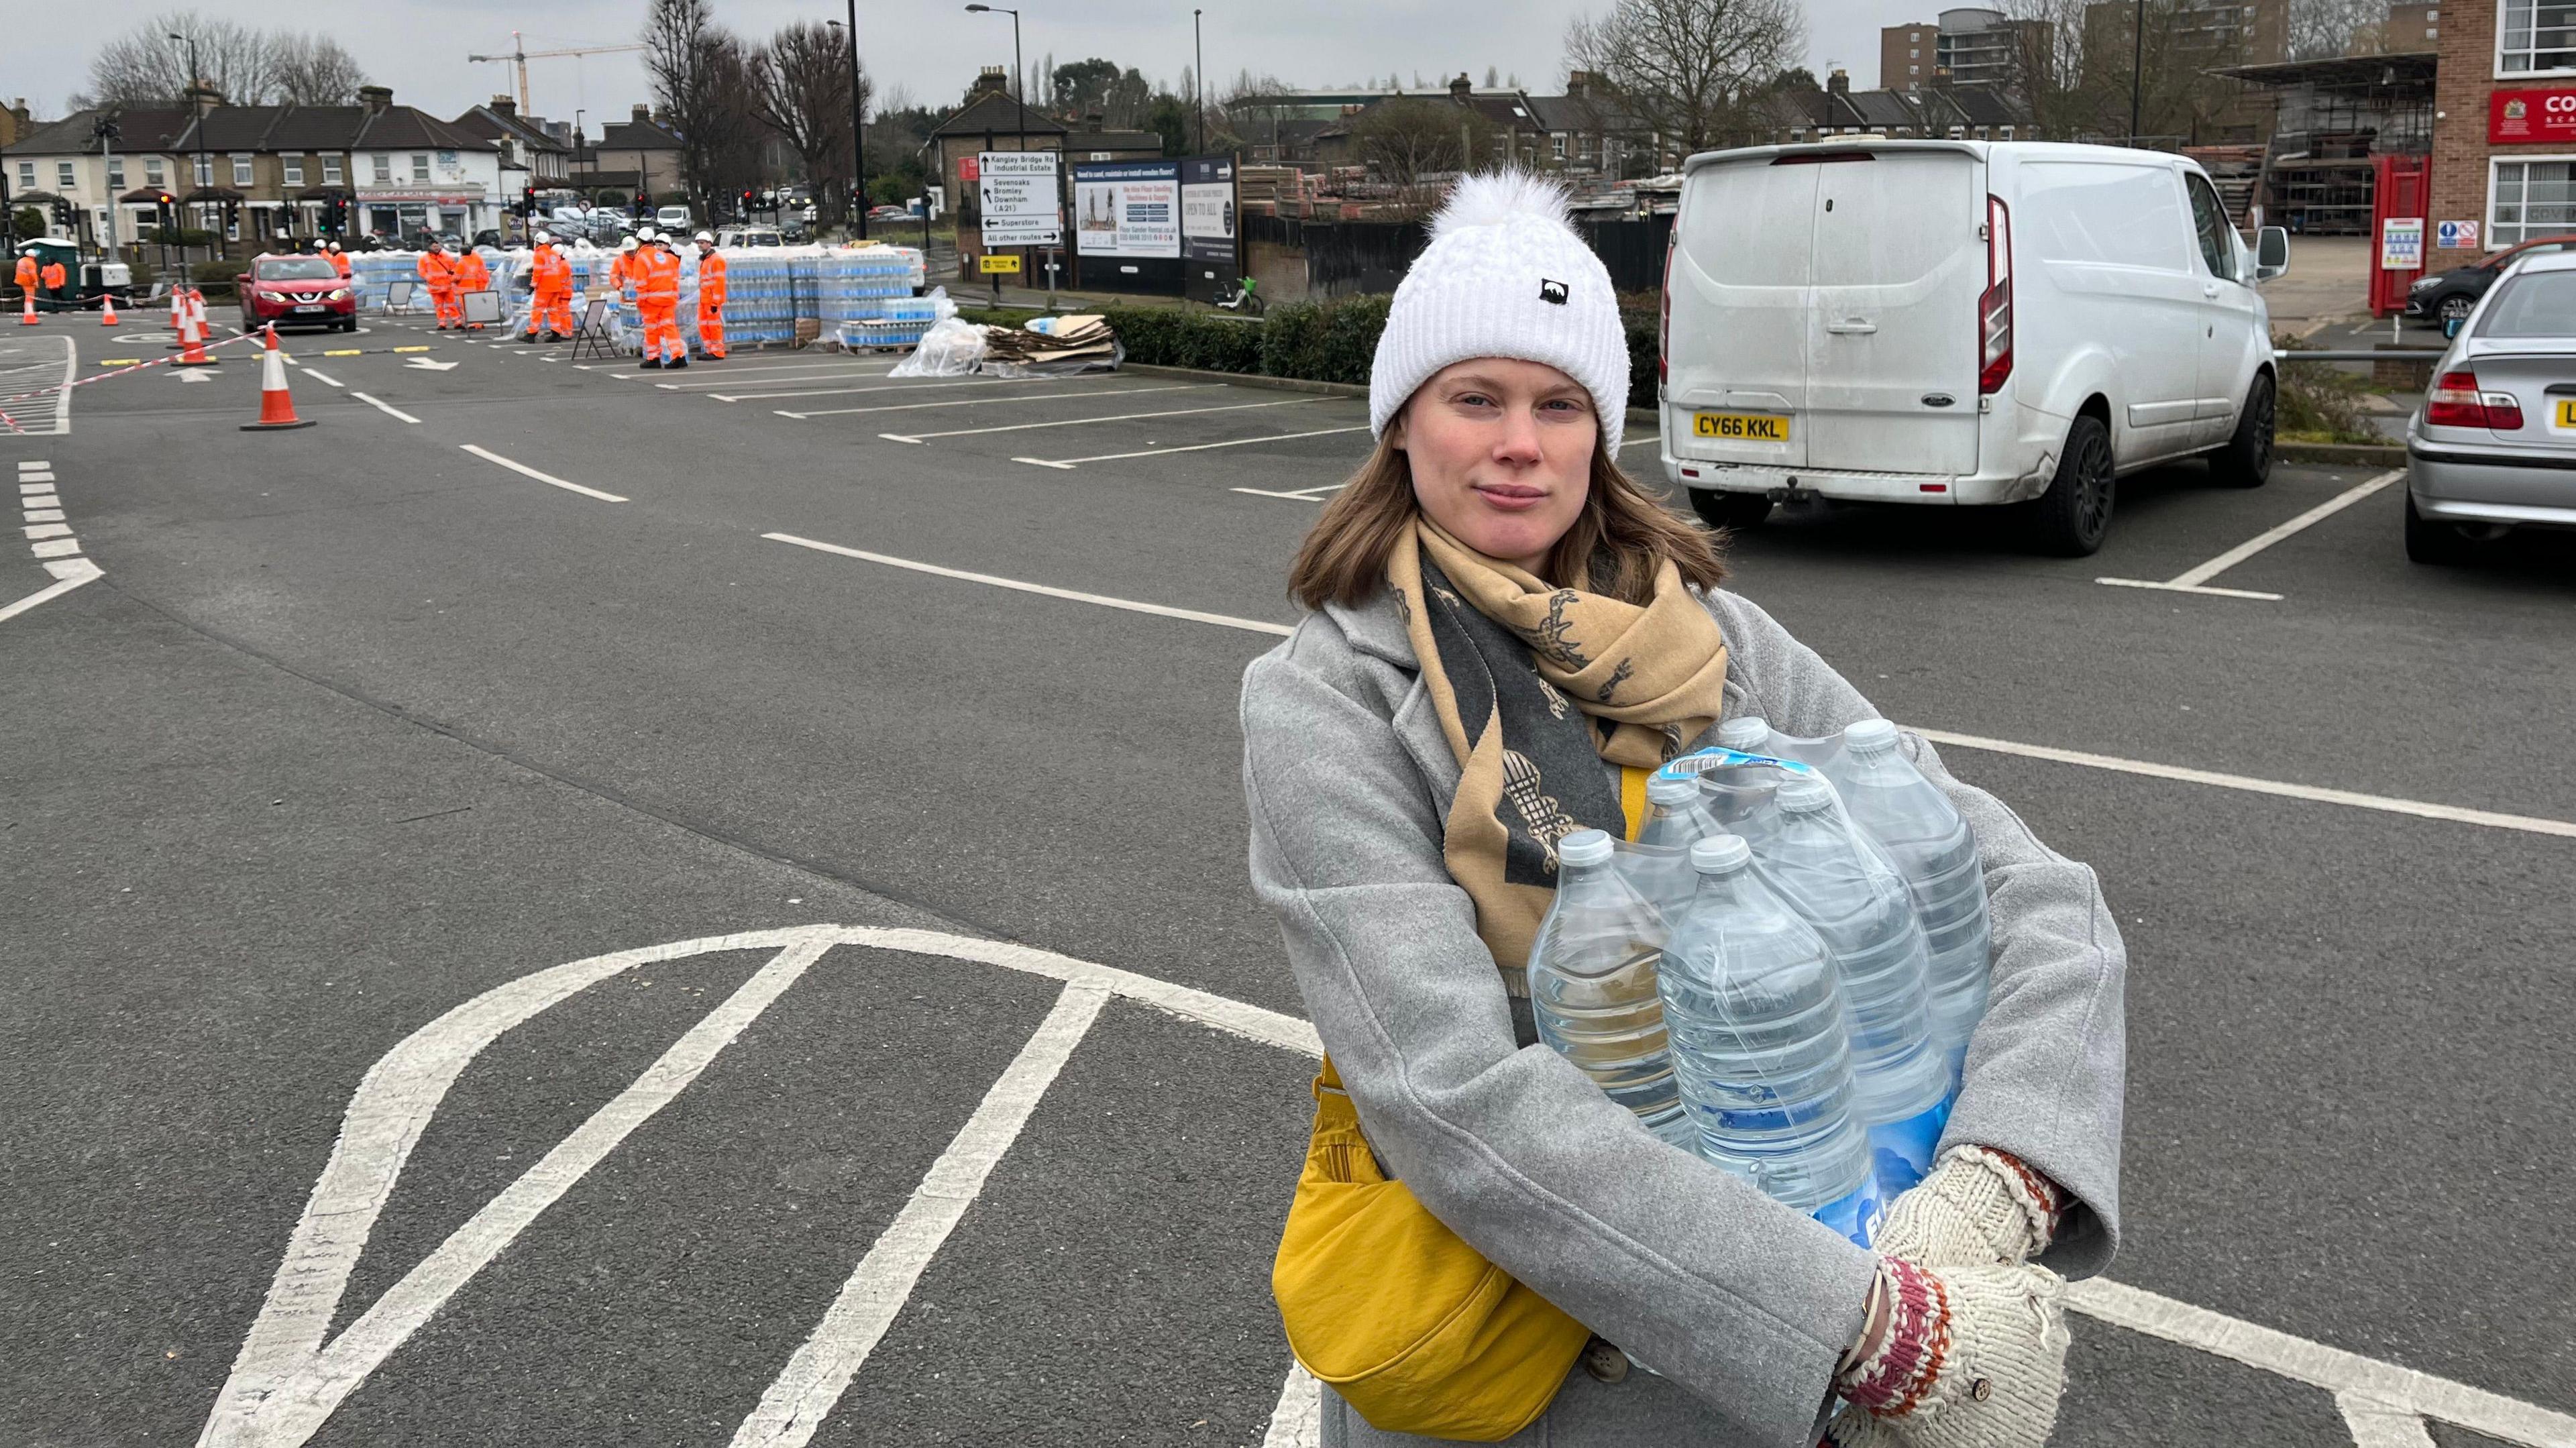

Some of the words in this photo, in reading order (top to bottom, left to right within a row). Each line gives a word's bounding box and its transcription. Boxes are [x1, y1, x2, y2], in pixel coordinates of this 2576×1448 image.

[991, 156, 1018, 164] Kangley
[1020, 155, 1042, 164] Bridge
[1044, 155, 1054, 163] Rd
[994, 188, 1022, 196] Bromley
[994, 205, 1016, 213] (A21)
[1185, 203, 1197, 216] OPEN
[1199, 203, 1206, 216] TO
[1207, 203, 1217, 215] ALL
[1002, 219, 1039, 227] Superstore
[1699, 416, 1742, 435] CY66
[1747, 419, 1780, 438] KKL
